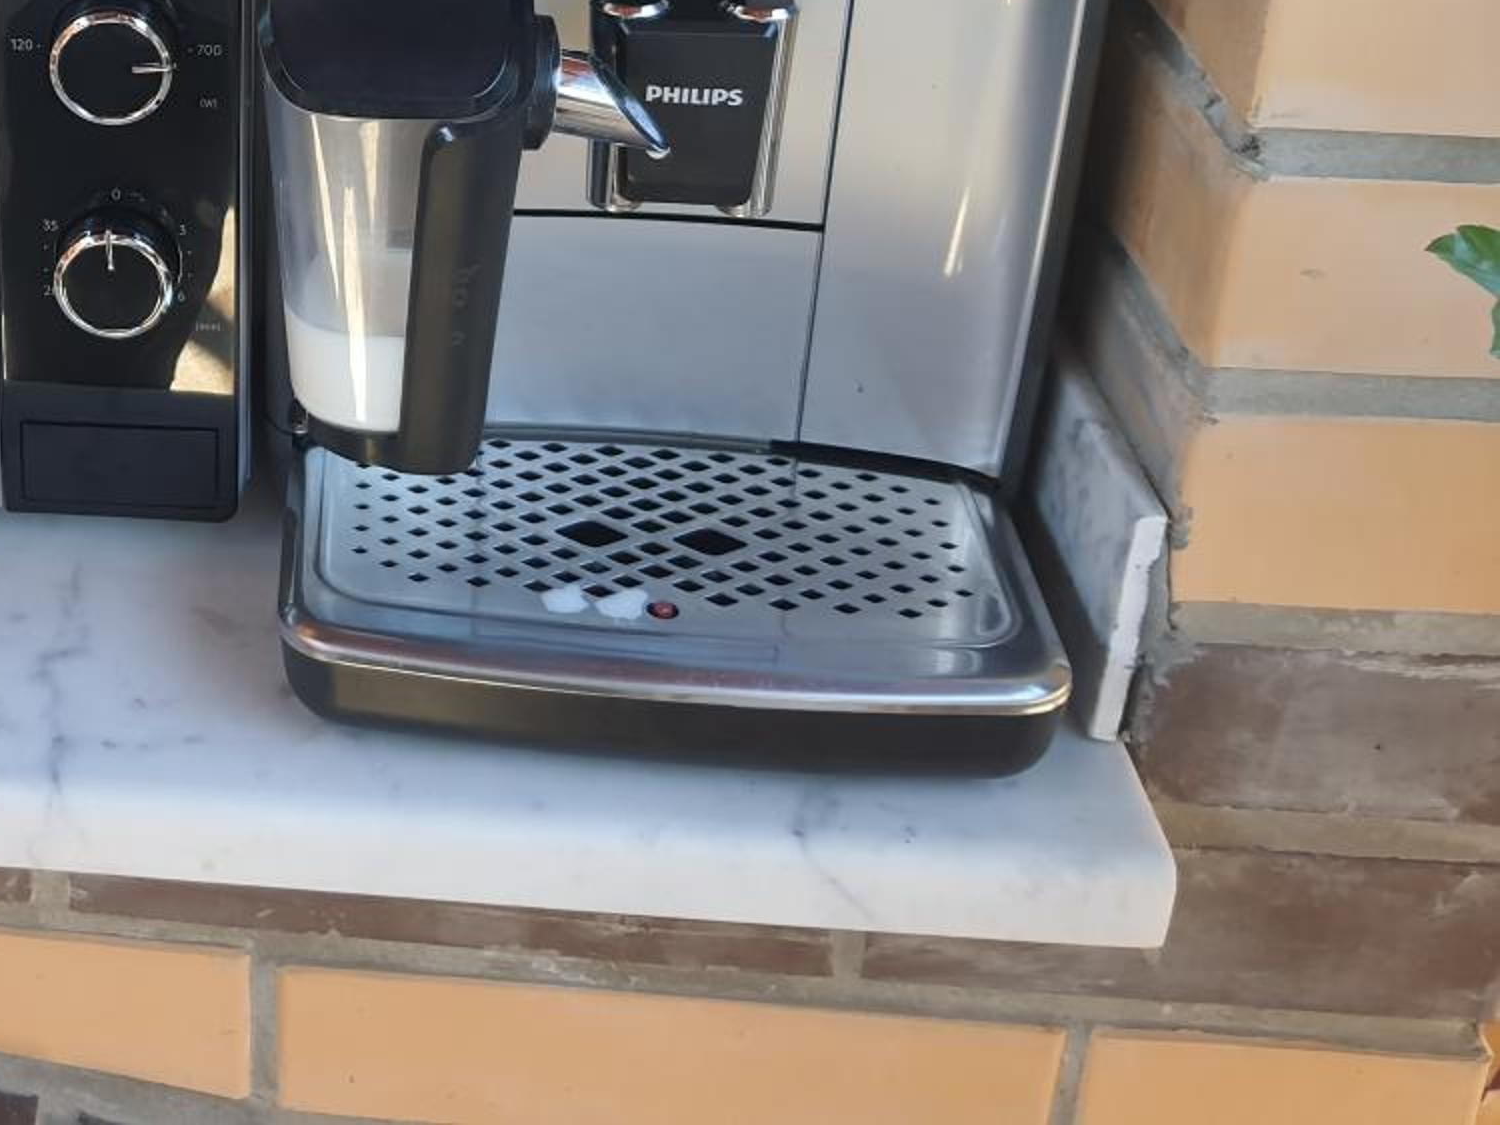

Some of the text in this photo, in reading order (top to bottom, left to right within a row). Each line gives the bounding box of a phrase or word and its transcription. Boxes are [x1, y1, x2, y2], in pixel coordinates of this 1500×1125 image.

[10, 38, 34, 51] 120
[196, 43, 223, 57] 700
[645, 85, 744, 106] PHILIPS
